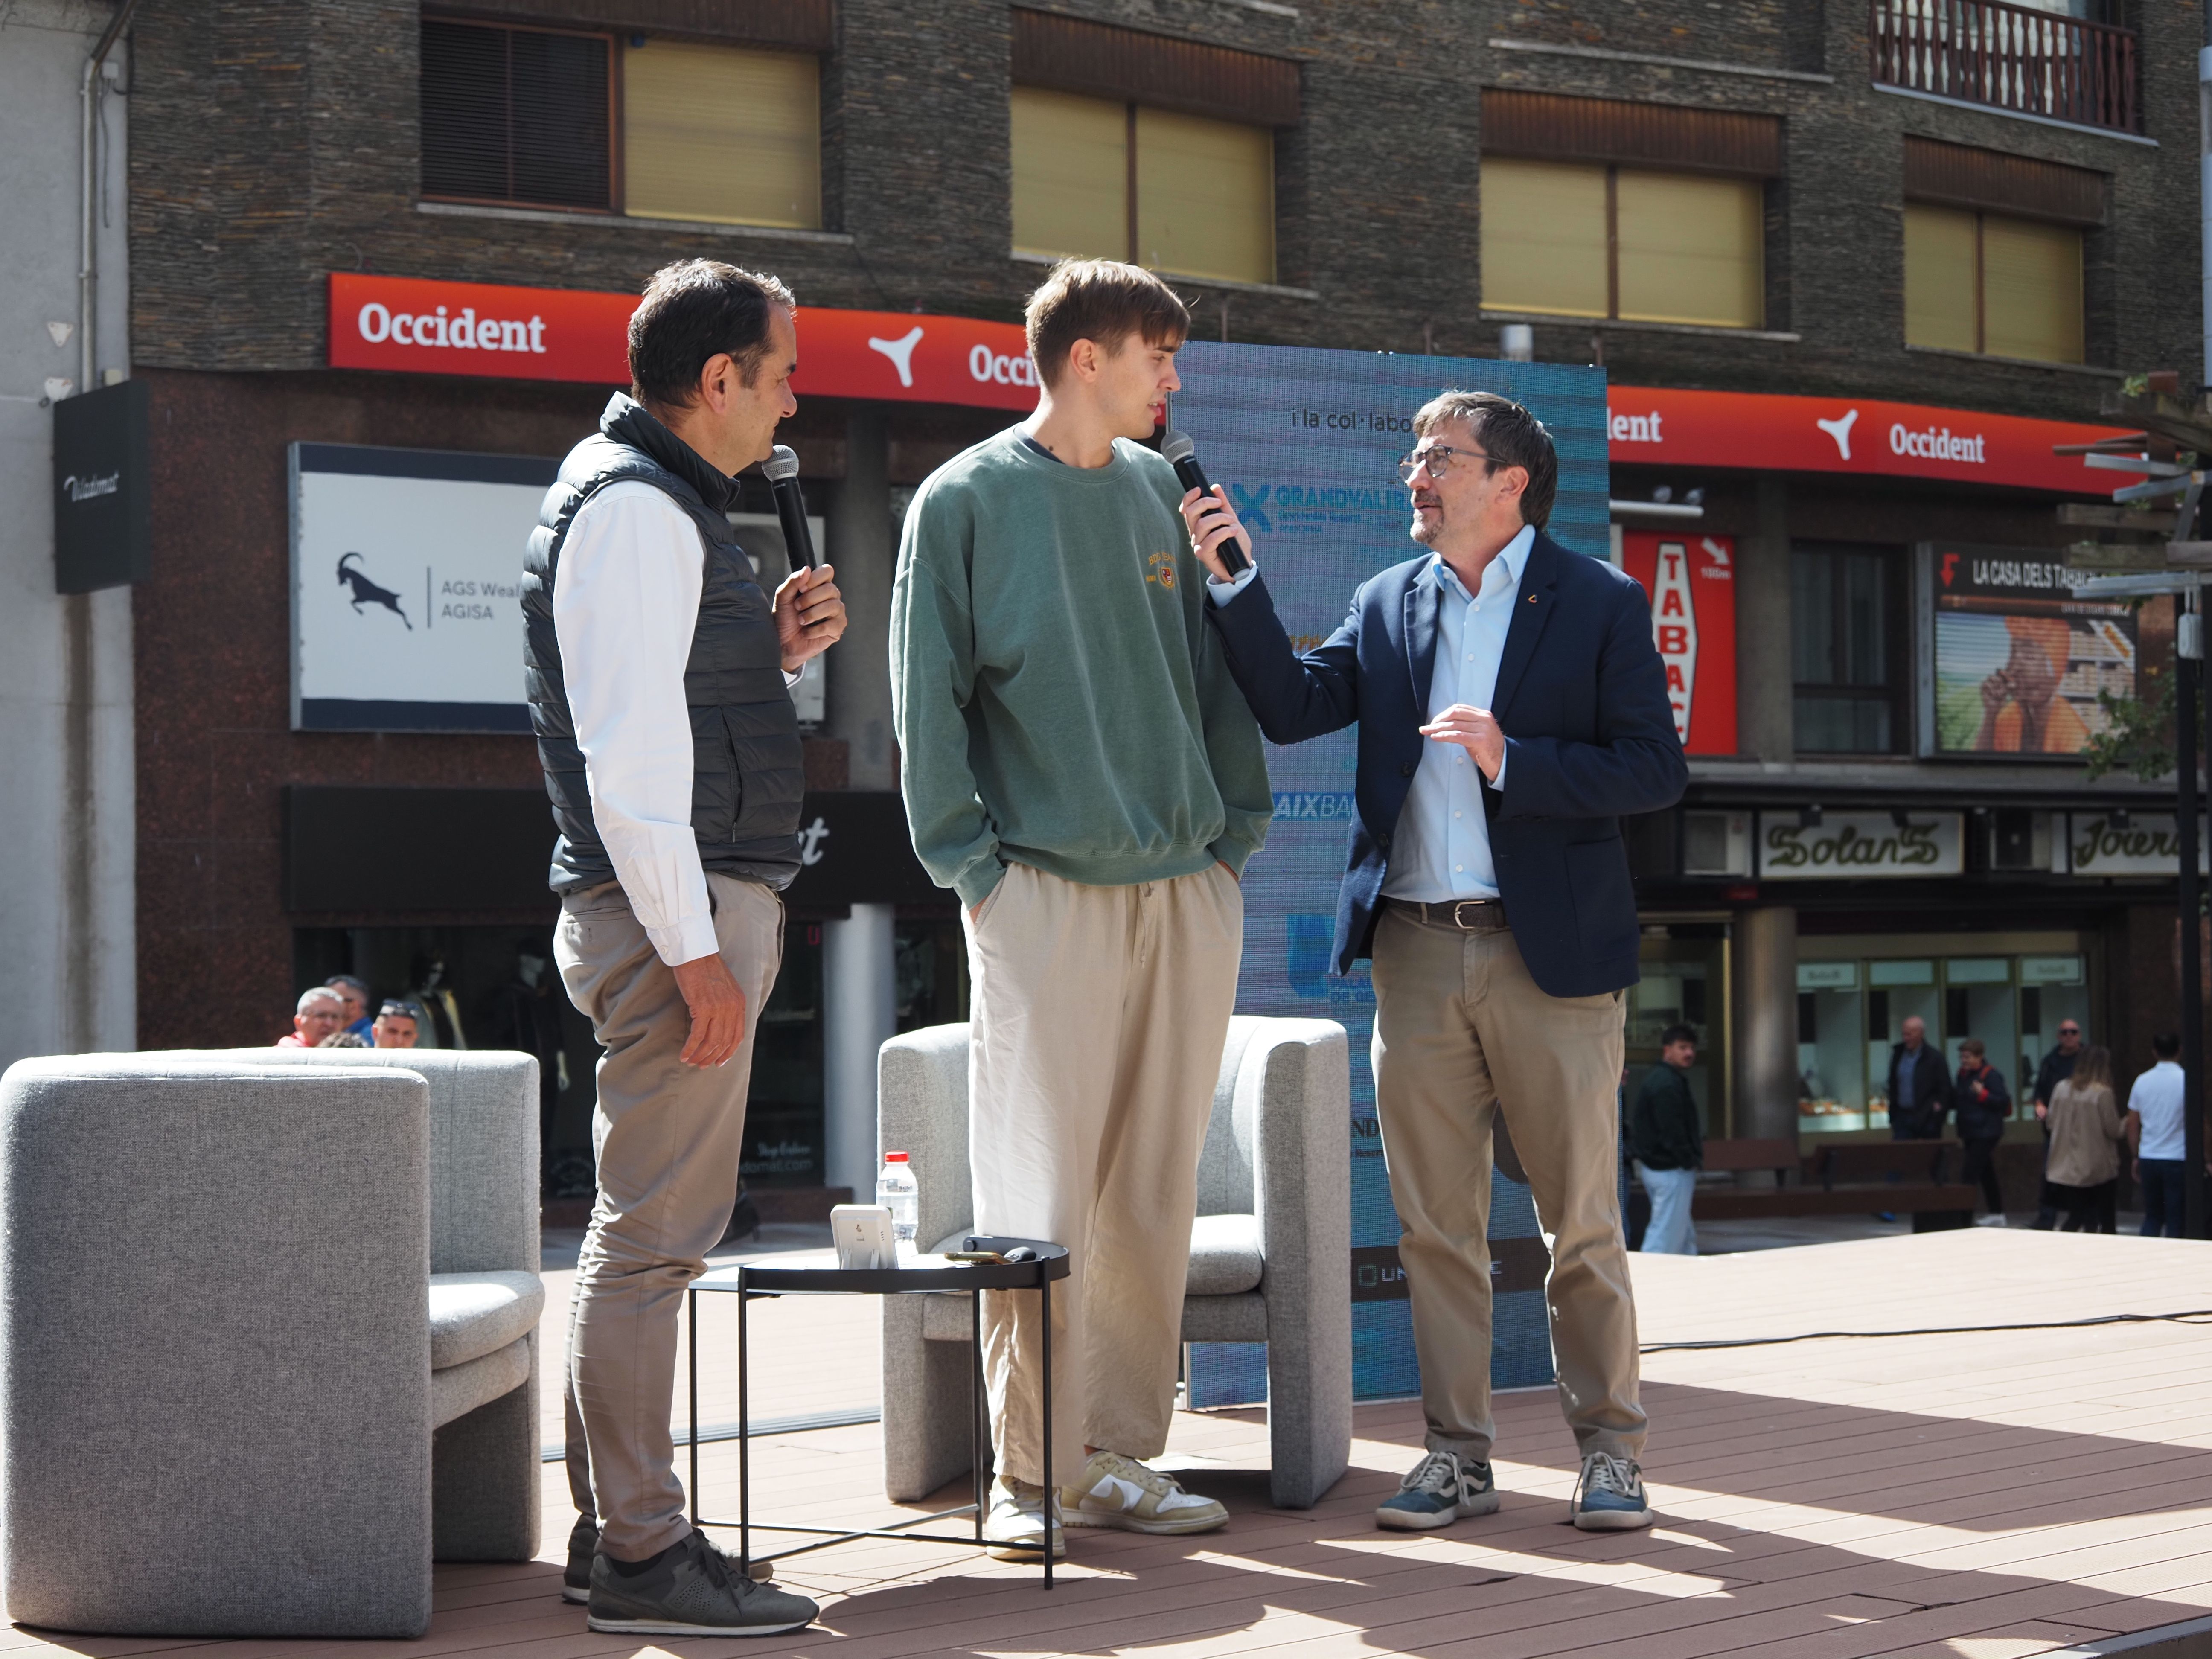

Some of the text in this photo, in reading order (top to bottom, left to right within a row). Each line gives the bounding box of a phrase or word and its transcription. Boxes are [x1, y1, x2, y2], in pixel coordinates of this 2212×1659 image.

[358, 302, 547, 353] Occident
[969, 344, 1040, 387] Occi
[1303, 408, 1319, 428] la
[1327, 410, 1412, 433] col·labo
[1889, 423, 1986, 463] Occident
[1973, 559, 1989, 585] LA
[1990, 559, 2022, 586] CASA
[2023, 562, 2052, 588] DELS
[442, 580, 521, 598] AGS Weal
[442, 603, 493, 619] AGISA
[1273, 795, 1350, 818] AIXBA
[2073, 819, 2179, 868] Joier
